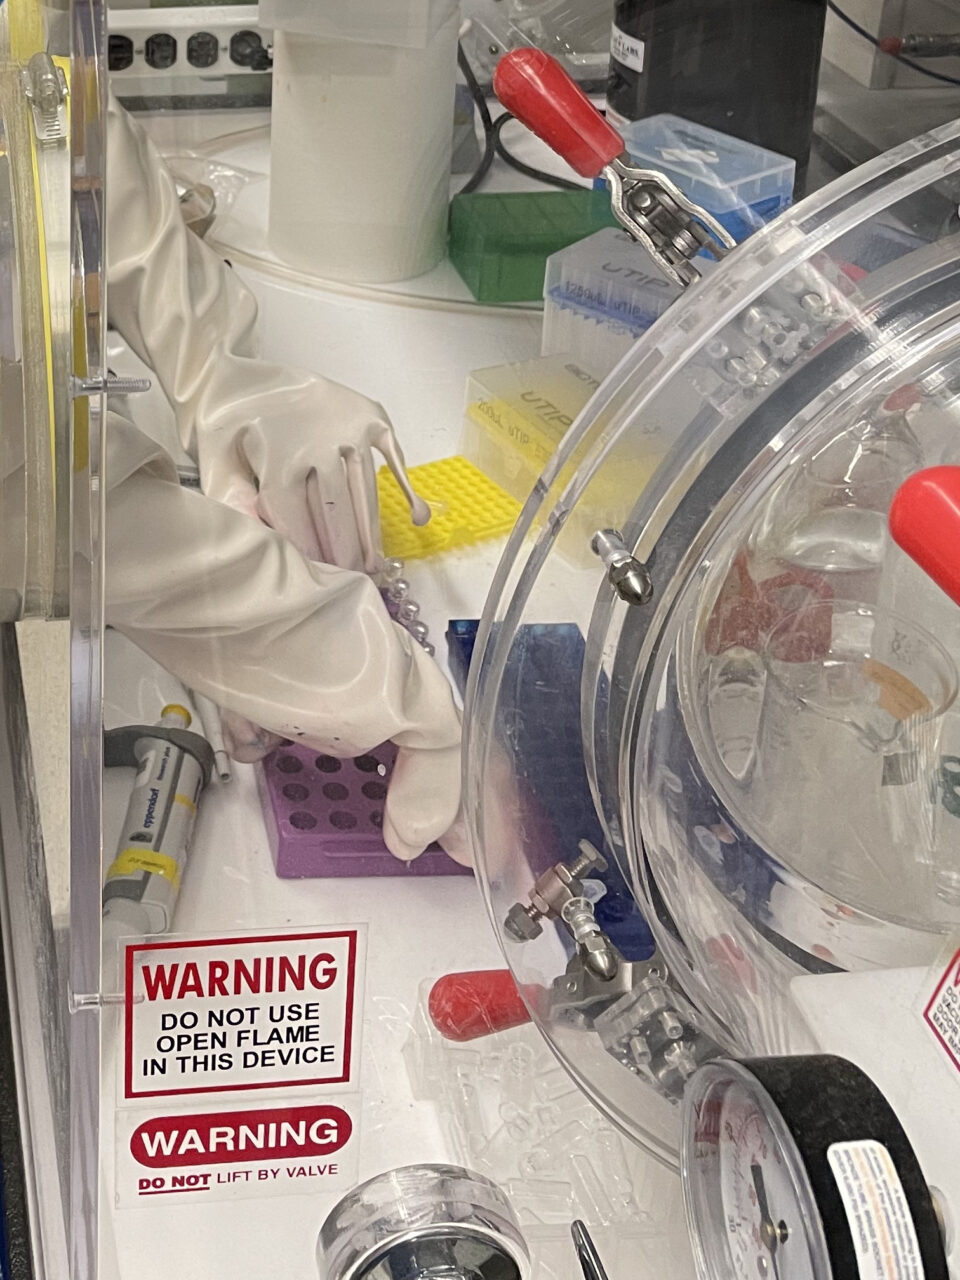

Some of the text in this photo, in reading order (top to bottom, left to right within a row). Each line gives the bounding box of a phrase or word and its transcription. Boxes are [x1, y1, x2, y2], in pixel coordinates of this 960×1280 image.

[144, 788, 159, 828] eppendorf
[141, 953, 338, 1001] WARNING
[942, 994, 960, 1026] VACU
[946, 986, 957, 1004] DO
[161, 1003, 320, 1030] DO NOT USE
[933, 1012, 948, 1036] MAY
[937, 1003, 958, 1037] DOOR
[156, 1025, 320, 1052] OPEN FLAME
[143, 1045, 335, 1076] IN THIS DEVICE
[141, 1118, 338, 1157] WARNING
[139, 1163, 338, 1192] DO NOT LIFT BY VALVE
